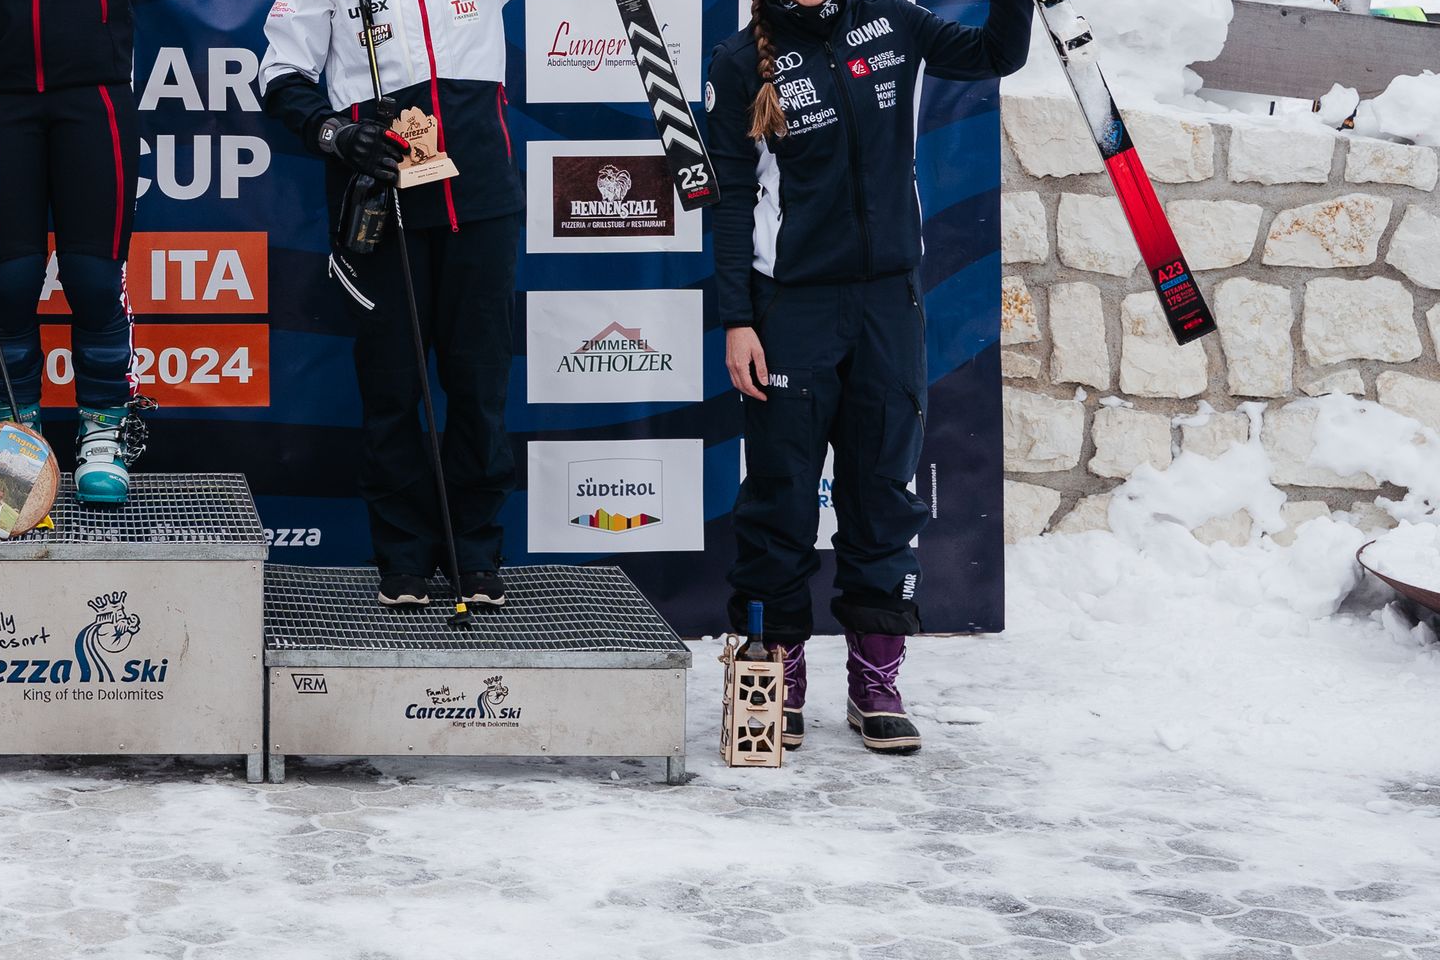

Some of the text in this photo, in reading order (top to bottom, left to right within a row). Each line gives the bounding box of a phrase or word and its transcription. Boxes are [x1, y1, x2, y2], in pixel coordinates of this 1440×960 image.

[846, 17, 894, 47] COLMAR
[547, 21, 627, 72] Lunger
[868, 49, 895, 64] CAISSE
[547, 58, 595, 68] Abdichtungen
[779, 77, 815, 98] GREEN
[789, 92, 822, 112] WEEZ
[786, 106, 836, 130] La Région
[678, 163, 709, 190] 23
[570, 199, 657, 219] HENNENSTALL
[561, 220, 666, 229] PIZZERIA GRILLSTUBE RESTAURANT
[151, 250, 254, 300] ITA
[1157, 261, 1185, 284] A23
[582, 339, 649, 352] ZIMMEREI
[557, 353, 673, 373] ANTHOLZER
[121, 658, 168, 684] Ski
[292, 674, 327, 693] VRM
[425, 684, 451, 697] Family
[23, 688, 164, 703] King of the Dolomites
[432, 692, 467, 706] Resort
[405, 702, 522, 720] Carezza Ski
[452, 720, 466, 729] King
